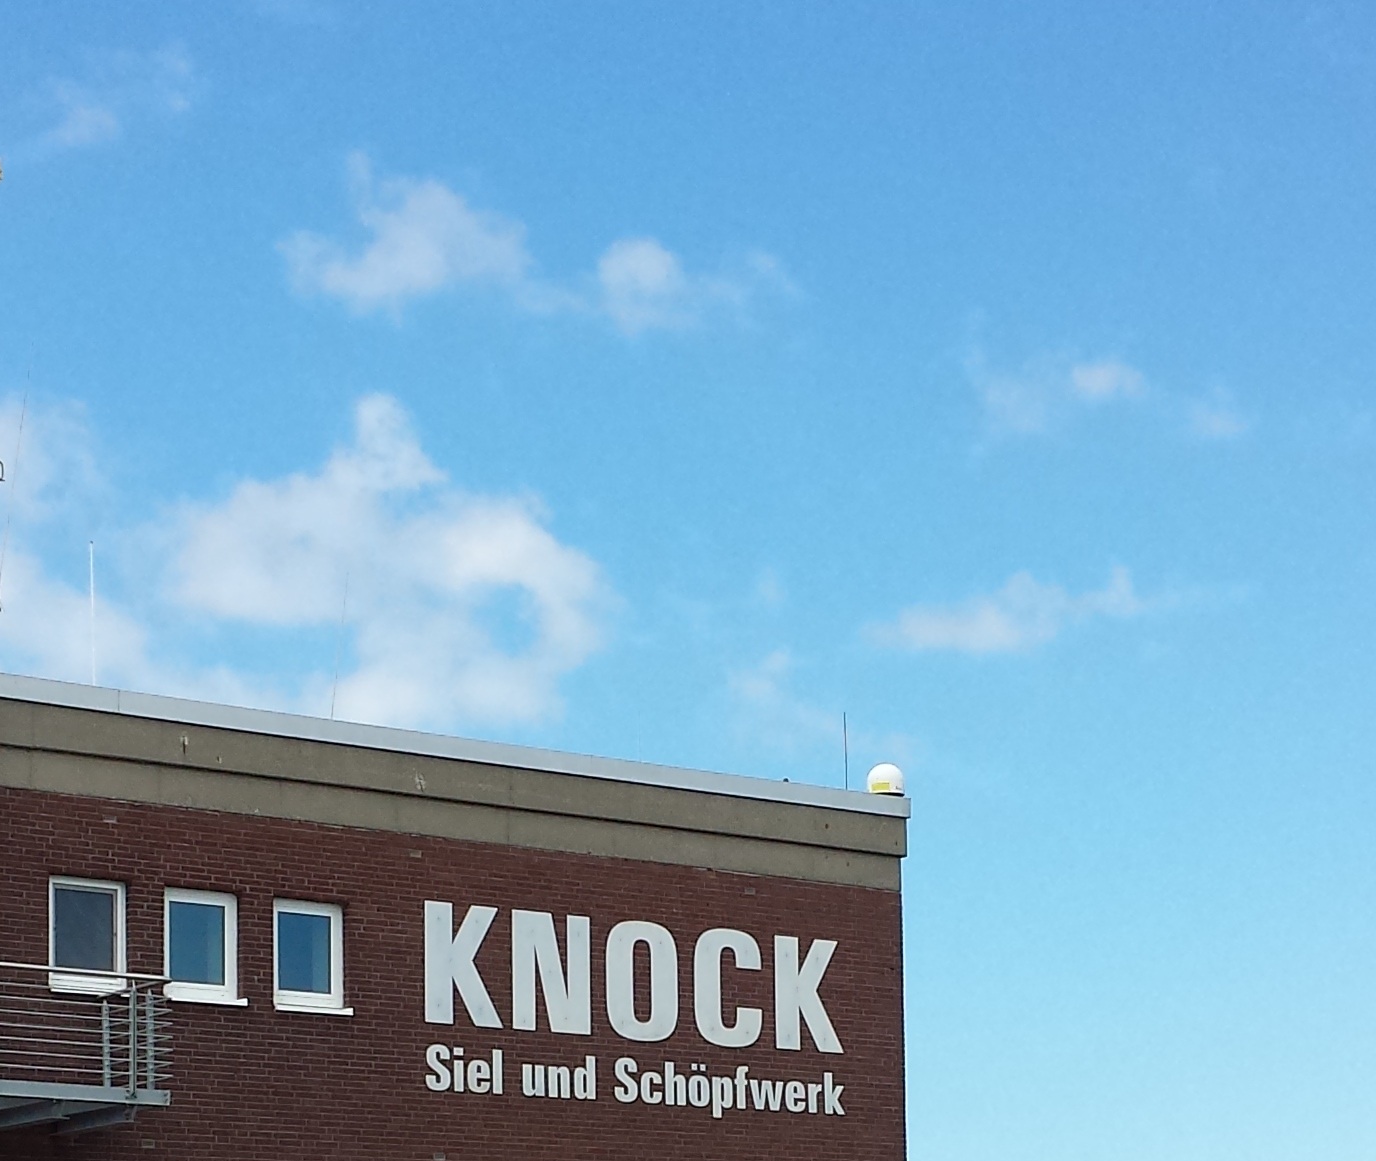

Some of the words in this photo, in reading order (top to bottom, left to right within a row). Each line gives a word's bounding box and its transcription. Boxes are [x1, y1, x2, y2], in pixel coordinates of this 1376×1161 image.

[423, 899, 845, 1054] KNOCK
[425, 1043, 504, 1095] Siel
[521, 1054, 597, 1100] und
[613, 1056, 846, 1119] Schöpfwerk
